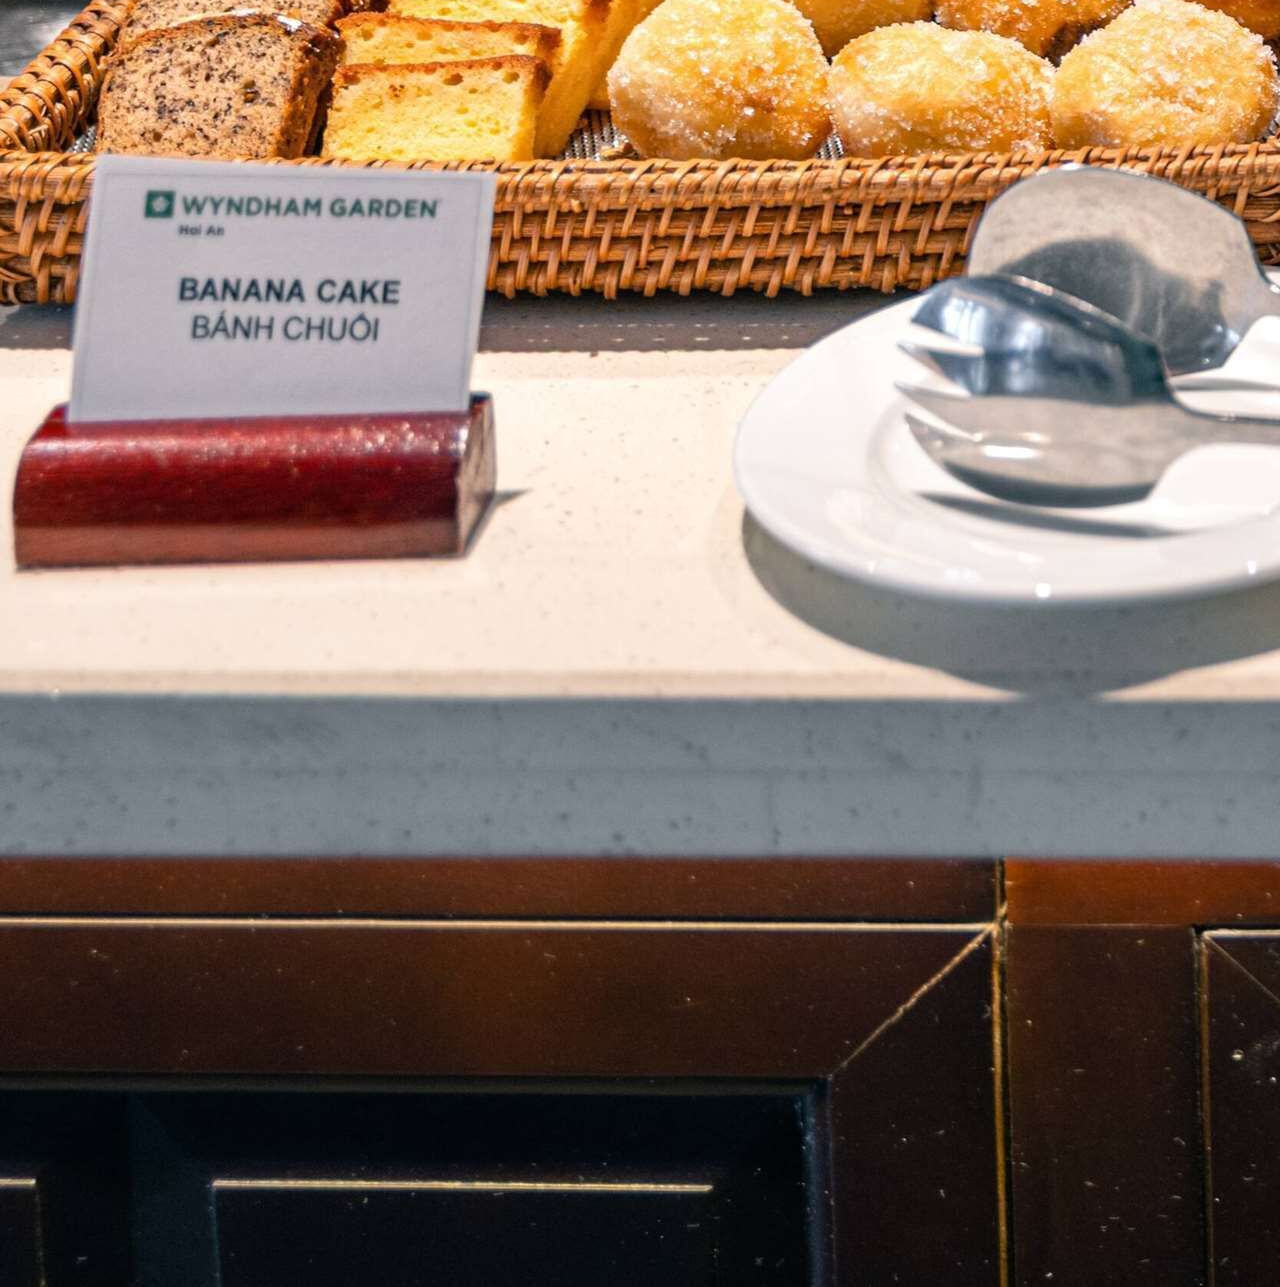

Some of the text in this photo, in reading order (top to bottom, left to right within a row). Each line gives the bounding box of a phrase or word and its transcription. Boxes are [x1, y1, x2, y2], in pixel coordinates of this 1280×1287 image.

[183, 197, 437, 219] WYNDHAM GARDEN
[179, 278, 400, 304] BANANA CAKE
[191, 311, 274, 339] BÁNH
